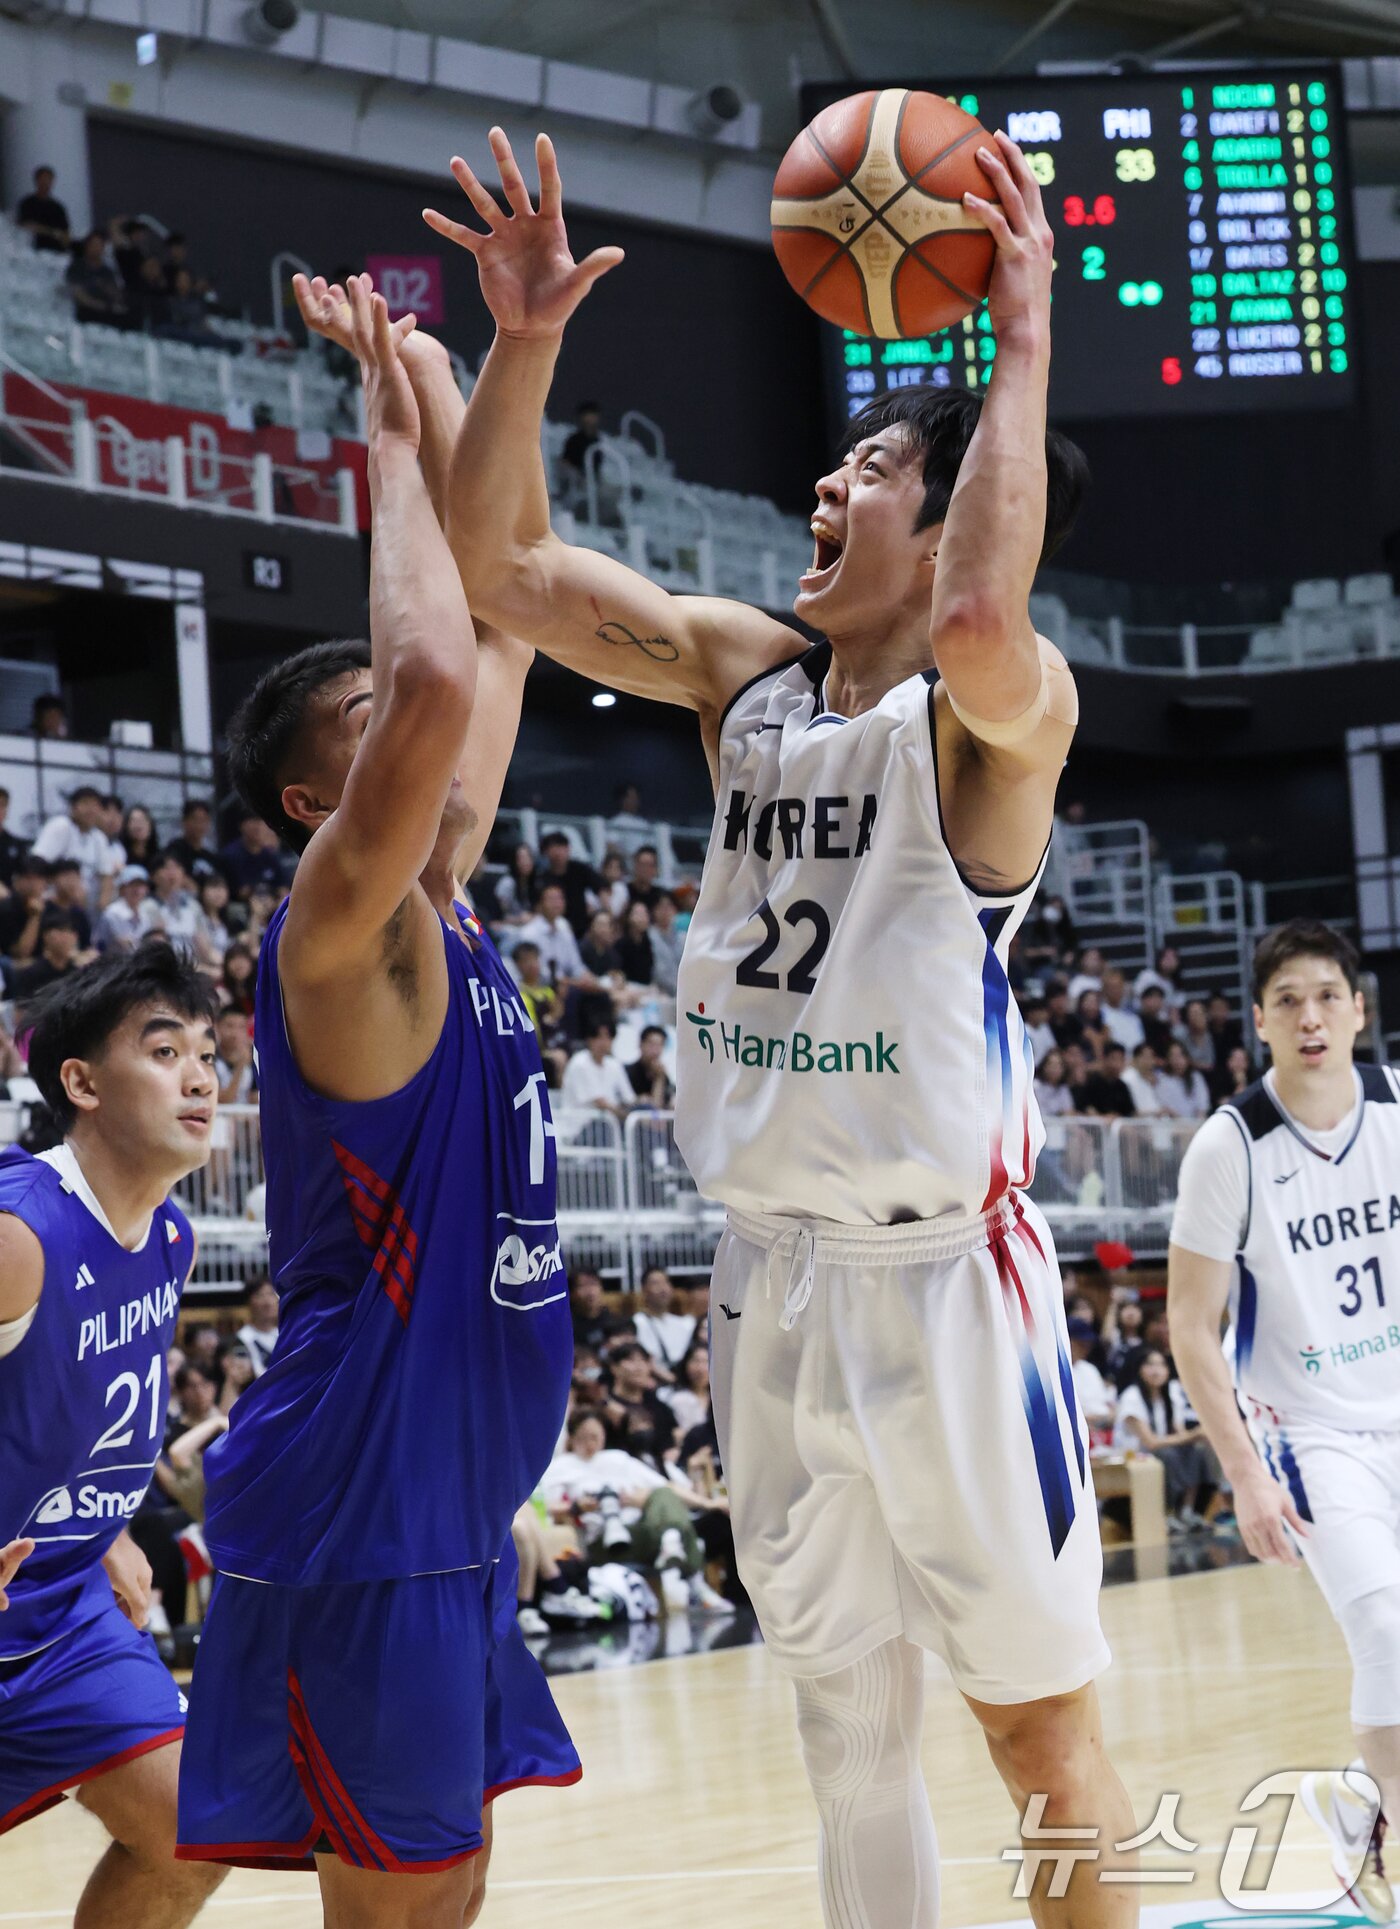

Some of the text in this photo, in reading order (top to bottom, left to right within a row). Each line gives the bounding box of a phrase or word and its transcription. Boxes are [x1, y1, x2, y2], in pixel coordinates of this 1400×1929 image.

[1288, 84, 1300, 105] 1
[1008, 110, 1062, 142] KOR
[1102, 108, 1152, 140] PHI
[1180, 113, 1197, 137] 2
[1287, 110, 1304, 133] 2
[1116, 148, 1156, 182] 33
[1319, 215, 1336, 239] 2
[1082, 246, 1106, 280] 2
[1298, 243, 1315, 266] 2
[1300, 270, 1317, 293] 2
[1304, 323, 1321, 347] 2
[1310, 351, 1322, 373] 1
[735, 896, 832, 996] 22
[720, 1021, 901, 1075] Han Bank
[1286, 1194, 1400, 1254] KOREA
[1335, 1256, 1386, 1317] 31
[1329, 1334, 1386, 1367] Hana
[88, 1353, 162, 1459] 21
